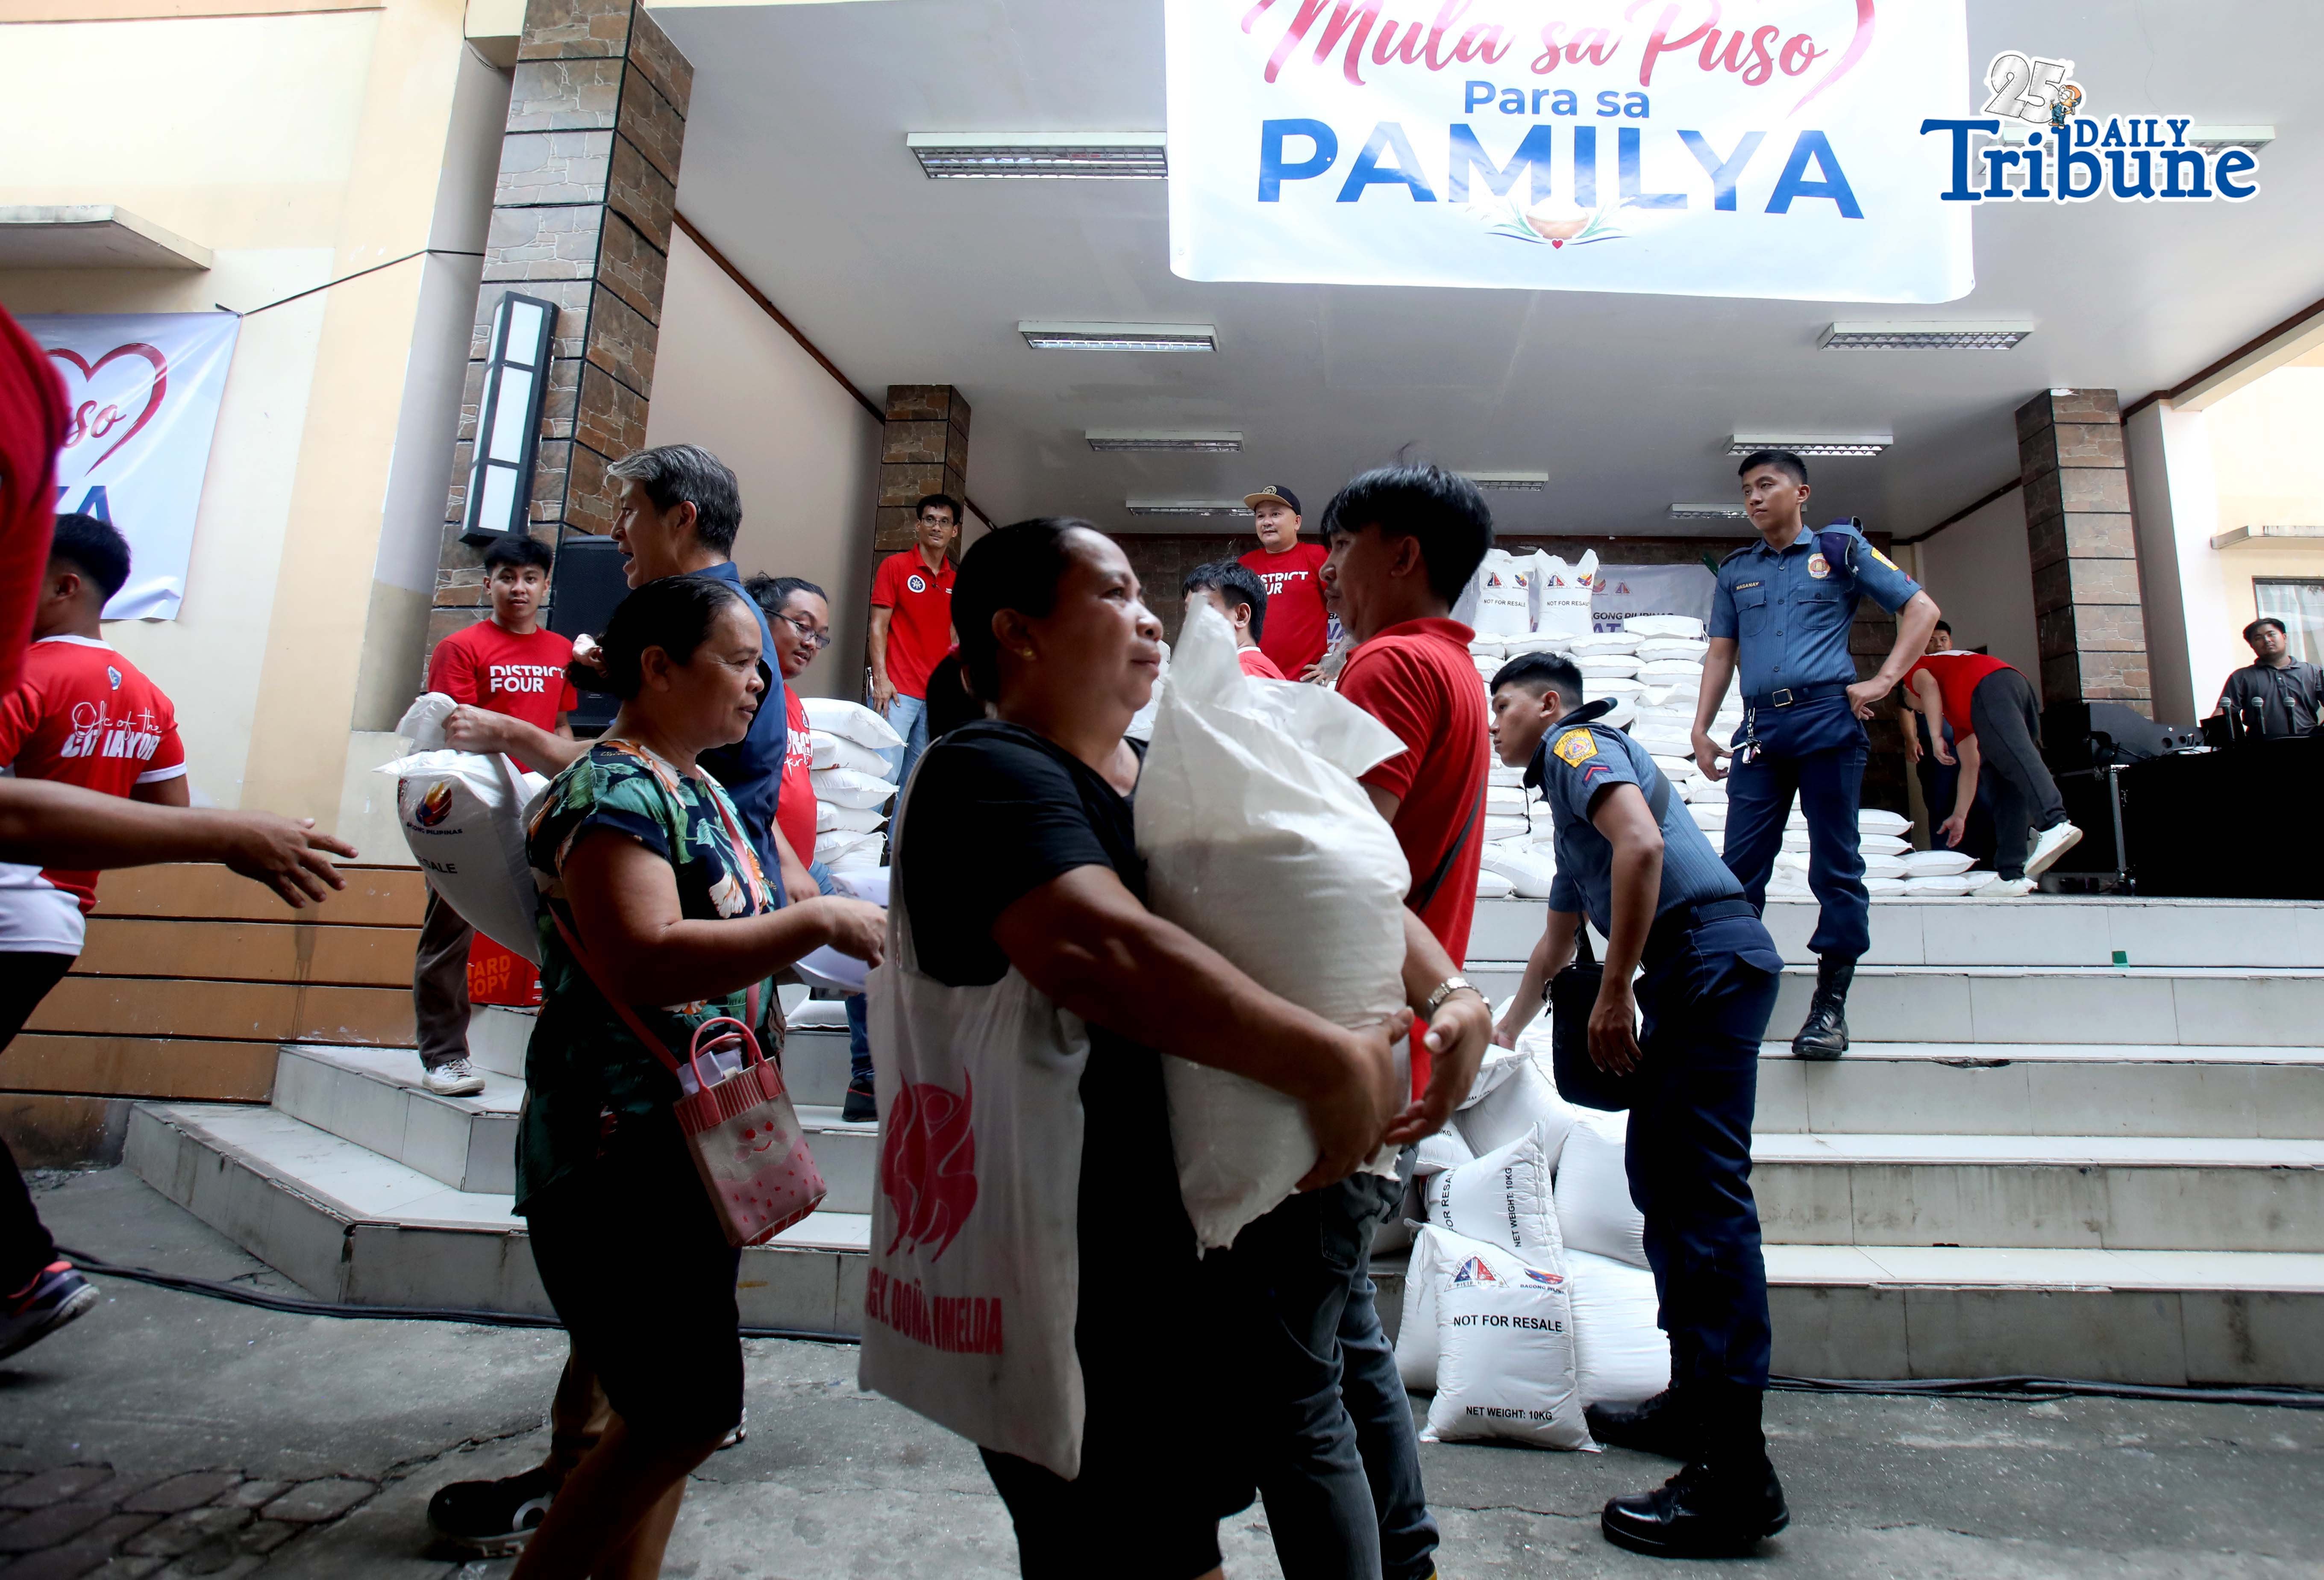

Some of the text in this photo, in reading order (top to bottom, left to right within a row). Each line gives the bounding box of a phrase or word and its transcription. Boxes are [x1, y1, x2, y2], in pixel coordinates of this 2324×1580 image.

[1242, 0, 1828, 86] Mula sa Puso
[1465, 81, 1649, 118] Para sa
[1257, 118, 1864, 219] PAMILYA
[1265, 583, 1283, 595] UR
[490, 677, 545, 693] FOUR
[117, 711, 137, 741] of
[137, 707, 162, 733] the
[1512, 1230, 1521, 1248] NET
[1454, 1315, 1562, 1332] NOT FOR RESALE
[1466, 1406, 1552, 1420] NET WEIGHT: 10KG
